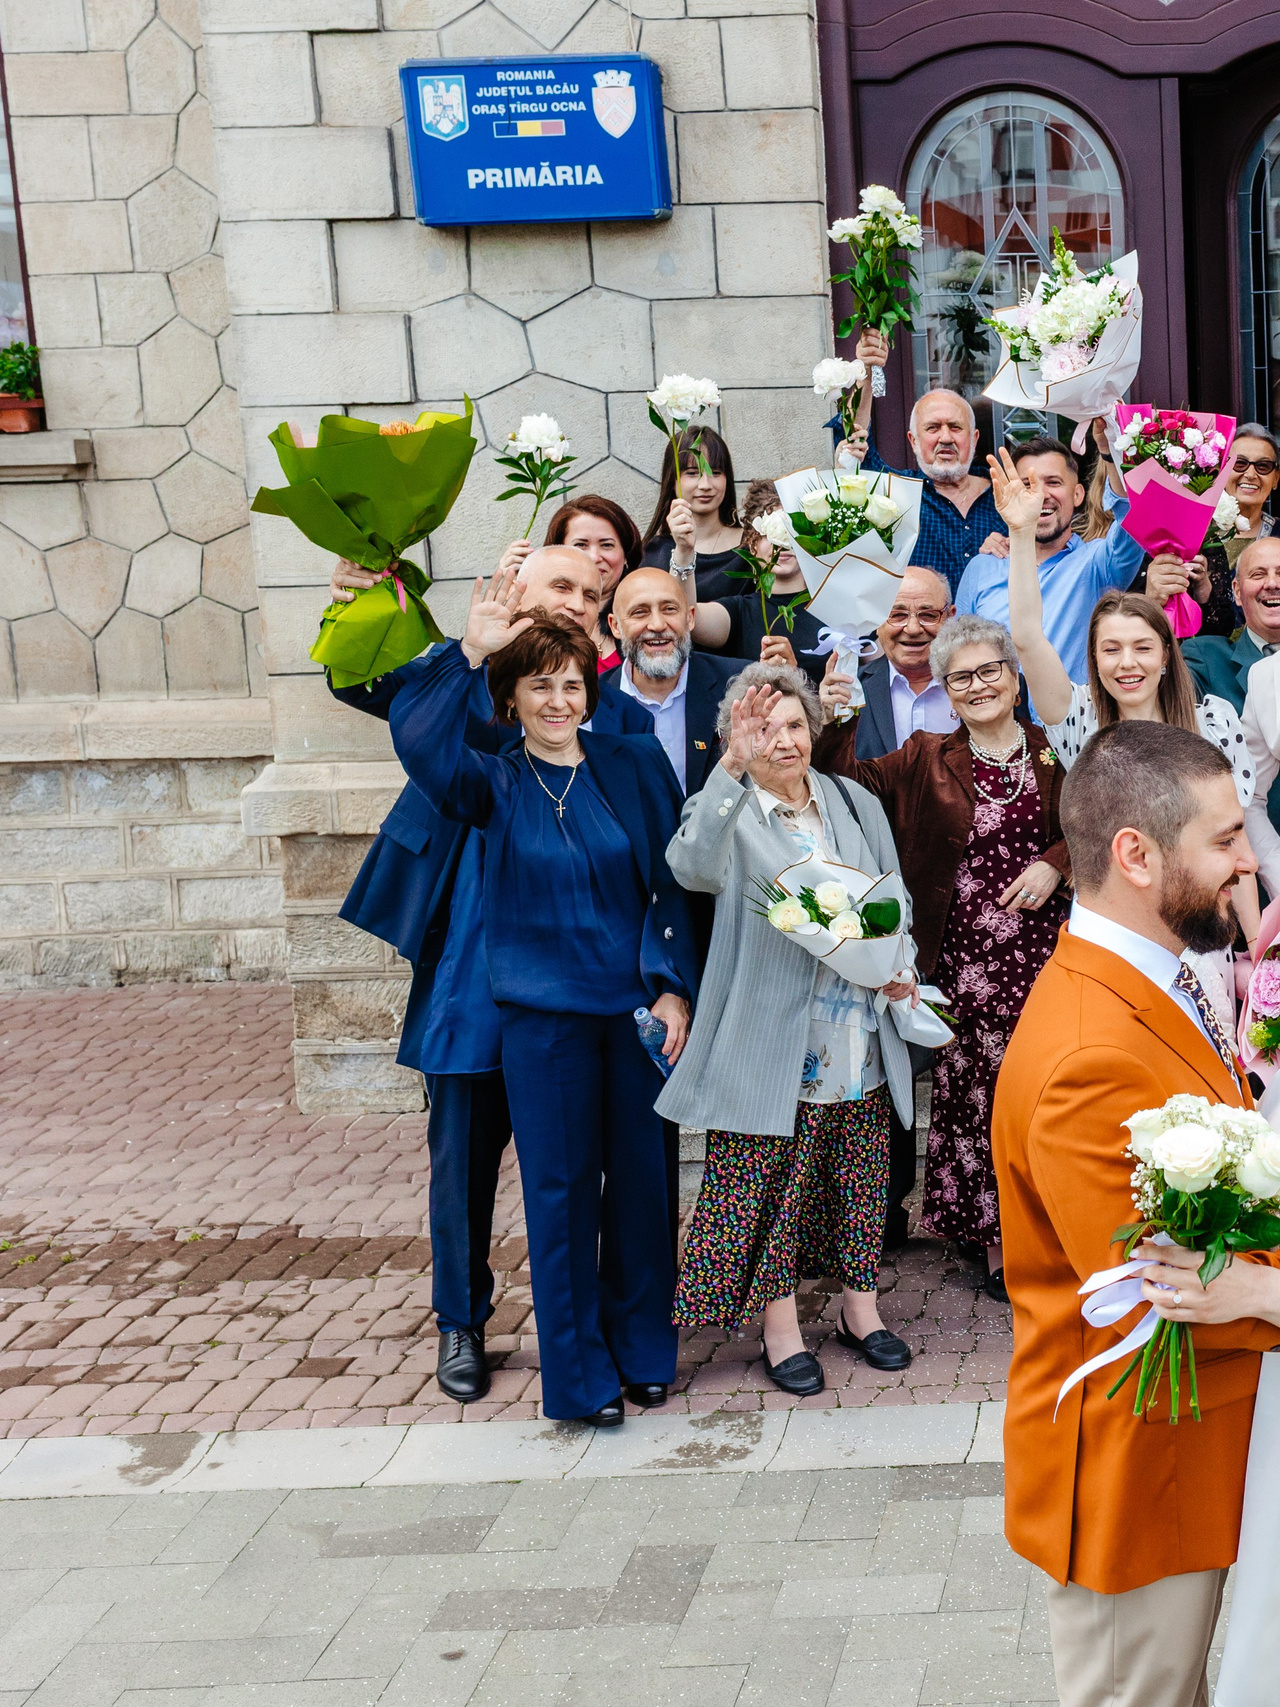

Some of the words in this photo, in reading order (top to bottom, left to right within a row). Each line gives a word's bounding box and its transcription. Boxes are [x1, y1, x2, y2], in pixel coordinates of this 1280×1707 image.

[496, 70, 556, 81] ROMANIA
[535, 83, 580, 95] BACĂU
[508, 102, 548, 113] TÎRGU
[550, 102, 587, 111] OCNA
[467, 162, 604, 189] PRIMĂRIA
